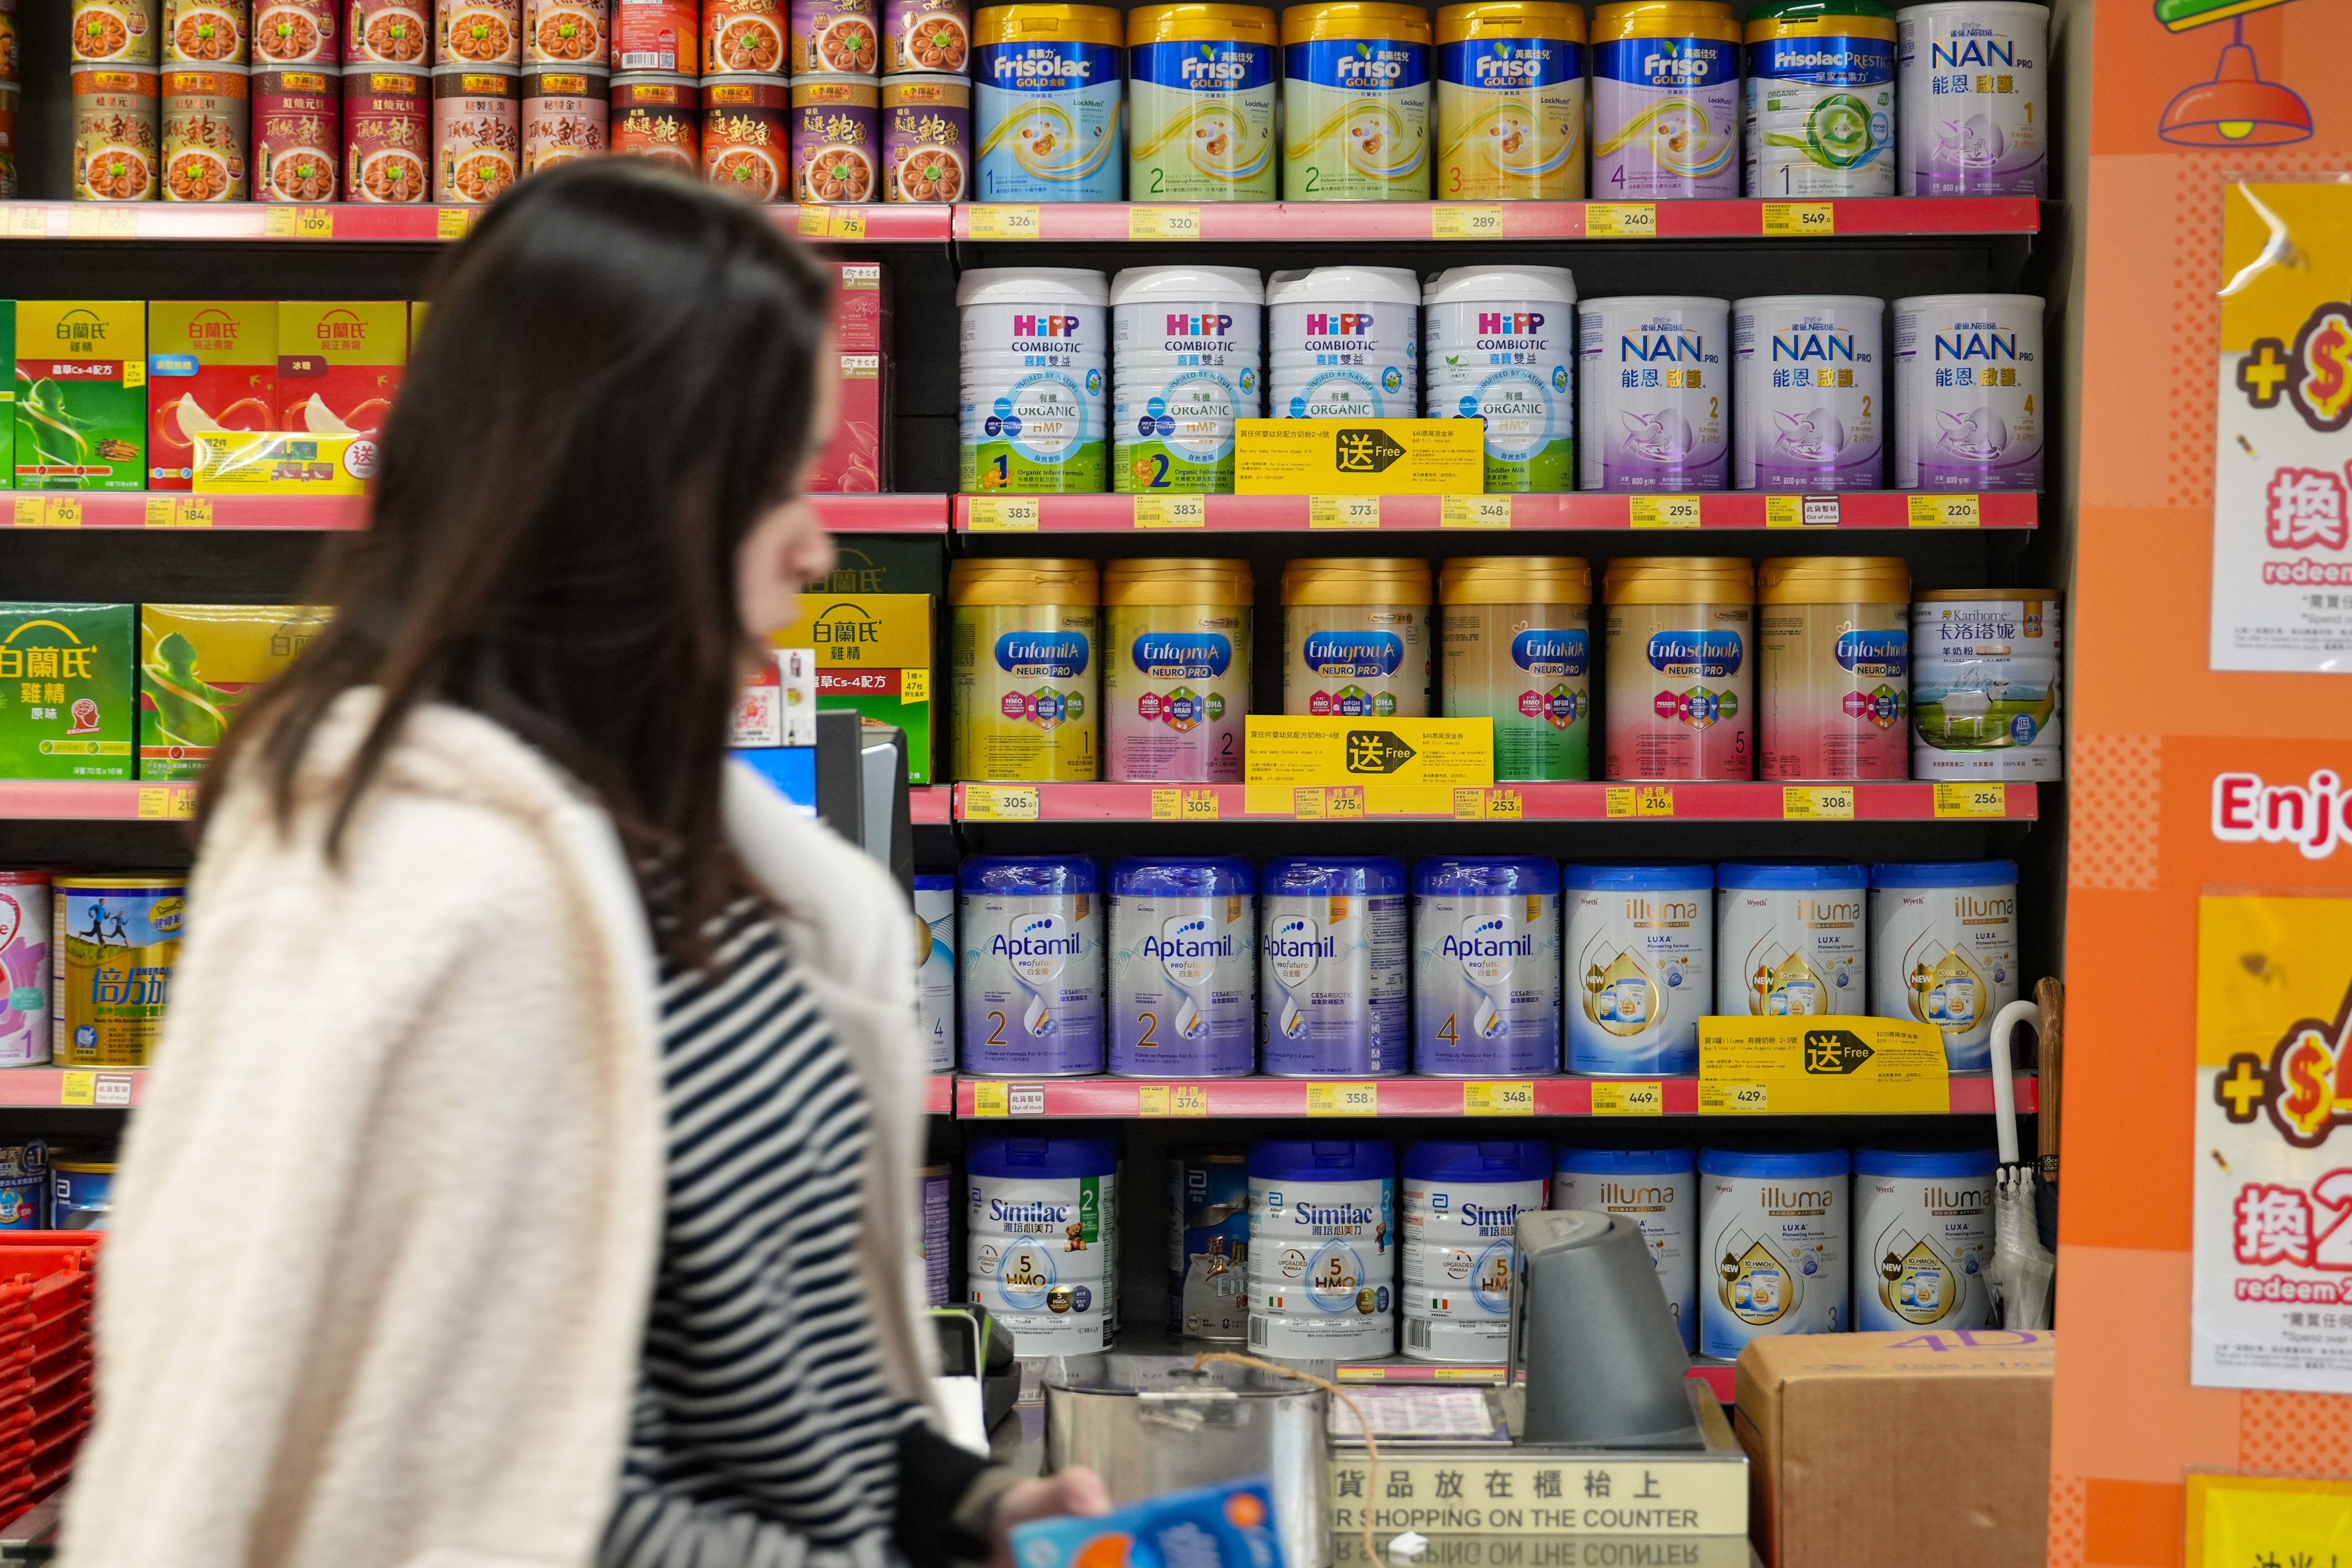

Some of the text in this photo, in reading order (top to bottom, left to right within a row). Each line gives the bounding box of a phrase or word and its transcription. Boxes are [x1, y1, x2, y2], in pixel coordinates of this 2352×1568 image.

[1027, 49, 1054, 59] 美素力
[1221, 52, 1253, 63] 美素佳兒
[1377, 50, 1408, 61] 美素佳兒
[1775, 51, 1843, 68] Frisolac
[1932, 40, 2015, 69] NAN
[994, 54, 1090, 78] Frisolac
[1181, 57, 1245, 79] Friso
[1338, 57, 1401, 79] Friso
[1017, 78, 1048, 87] GOLD
[1190, 79, 1222, 87] GOLD
[1816, 72, 1867, 82] 皇家美素力
[1932, 75, 1968, 94] 能恩
[1540, 97, 1569, 105] LockNutri
[2025, 102, 2033, 124] 1
[1150, 168, 1164, 194] 2
[1450, 167, 1461, 192] 3
[1611, 164, 1627, 190] 4
[1780, 164, 1789, 195] 1
[1009, 216, 1036, 226] 326.0
[1169, 218, 1198, 229] 320.0
[1802, 213, 1831, 225] 549.0
[188, 322, 238, 339] 白蘭氏
[1014, 315, 1079, 337] HiPP
[1167, 314, 1232, 336] HiPP
[56, 323, 107, 340] 白蘭氏
[1011, 342, 1080, 353] COMBIOTIC
[1165, 341, 1234, 352] COMBIOTIC
[1622, 335, 1702, 362] NAN
[1014, 372, 1044, 393] INSPIRED
[1056, 372, 1080, 394] NATURE
[1621, 369, 1659, 388] 能恩
[1039, 394, 1057, 403] 有機
[1018, 405, 1076, 416] ORGANIC
[1171, 404, 1229, 416] ORGANIC
[1033, 422, 1063, 432] HMP
[1339, 434, 1373, 470] 送
[1376, 446, 1400, 457] Free
[1018, 469, 1039, 477] Organic
[1040, 468, 1059, 476] Infant
[1198, 468, 1225, 477] Follow-on
[1174, 505, 1202, 515] 383.0
[1670, 505, 1698, 516] 295.0
[1948, 505, 1977, 516] 220.0
[1954, 610, 2007, 621] Karihome
[813, 621, 879, 643] 白蘭氏
[1936, 623, 2015, 640] 卡洛塔妮
[831, 646, 860, 661] 雞精
[1942, 647, 1973, 655] 羊奶粉
[1017, 666, 1070, 676] NEURO PRO
[1152, 667, 1208, 677] NEURO PRO
[30, 707, 57, 720] 原味
[2019, 717, 2029, 728] 低
[1736, 731, 1745, 754] 5
[1349, 735, 1385, 771] 送
[1386, 747, 1411, 759] Free
[1004, 797, 1033, 808] 305.0
[1646, 798, 1671, 809] 216.0
[1974, 793, 2002, 804] 256.0
[1334, 800, 1361, 810] 275.0
[1493, 800, 1520, 811] 253.0
[1627, 899, 1697, 919] illuma
[1797, 899, 1861, 921] illuma
[1955, 896, 2014, 919] illuma
[992, 932, 1080, 959] Aptamil
[1144, 934, 1232, 961] Aptamil
[1586, 976, 1604, 984] NEW
[1754, 976, 1774, 986] NEW
[985, 1010, 1007, 1045] 2
[1436, 1011, 1460, 1047] 4
[1177, 1097, 1205, 1108] 376.0
[1503, 1091, 1532, 1102] 348.0
[1737, 1091, 1766, 1102] 429.0
[990, 1198, 1067, 1222] Similac
[1295, 1202, 1373, 1225] Similac
[1004, 1223, 1053, 1233] 雅培心美力
[1315, 1277, 1355, 1291] HMO
[2237, 1275, 2338, 1303] redeem
[1360, 1509, 1698, 1527] SHOPPING ON THE COUNTER
